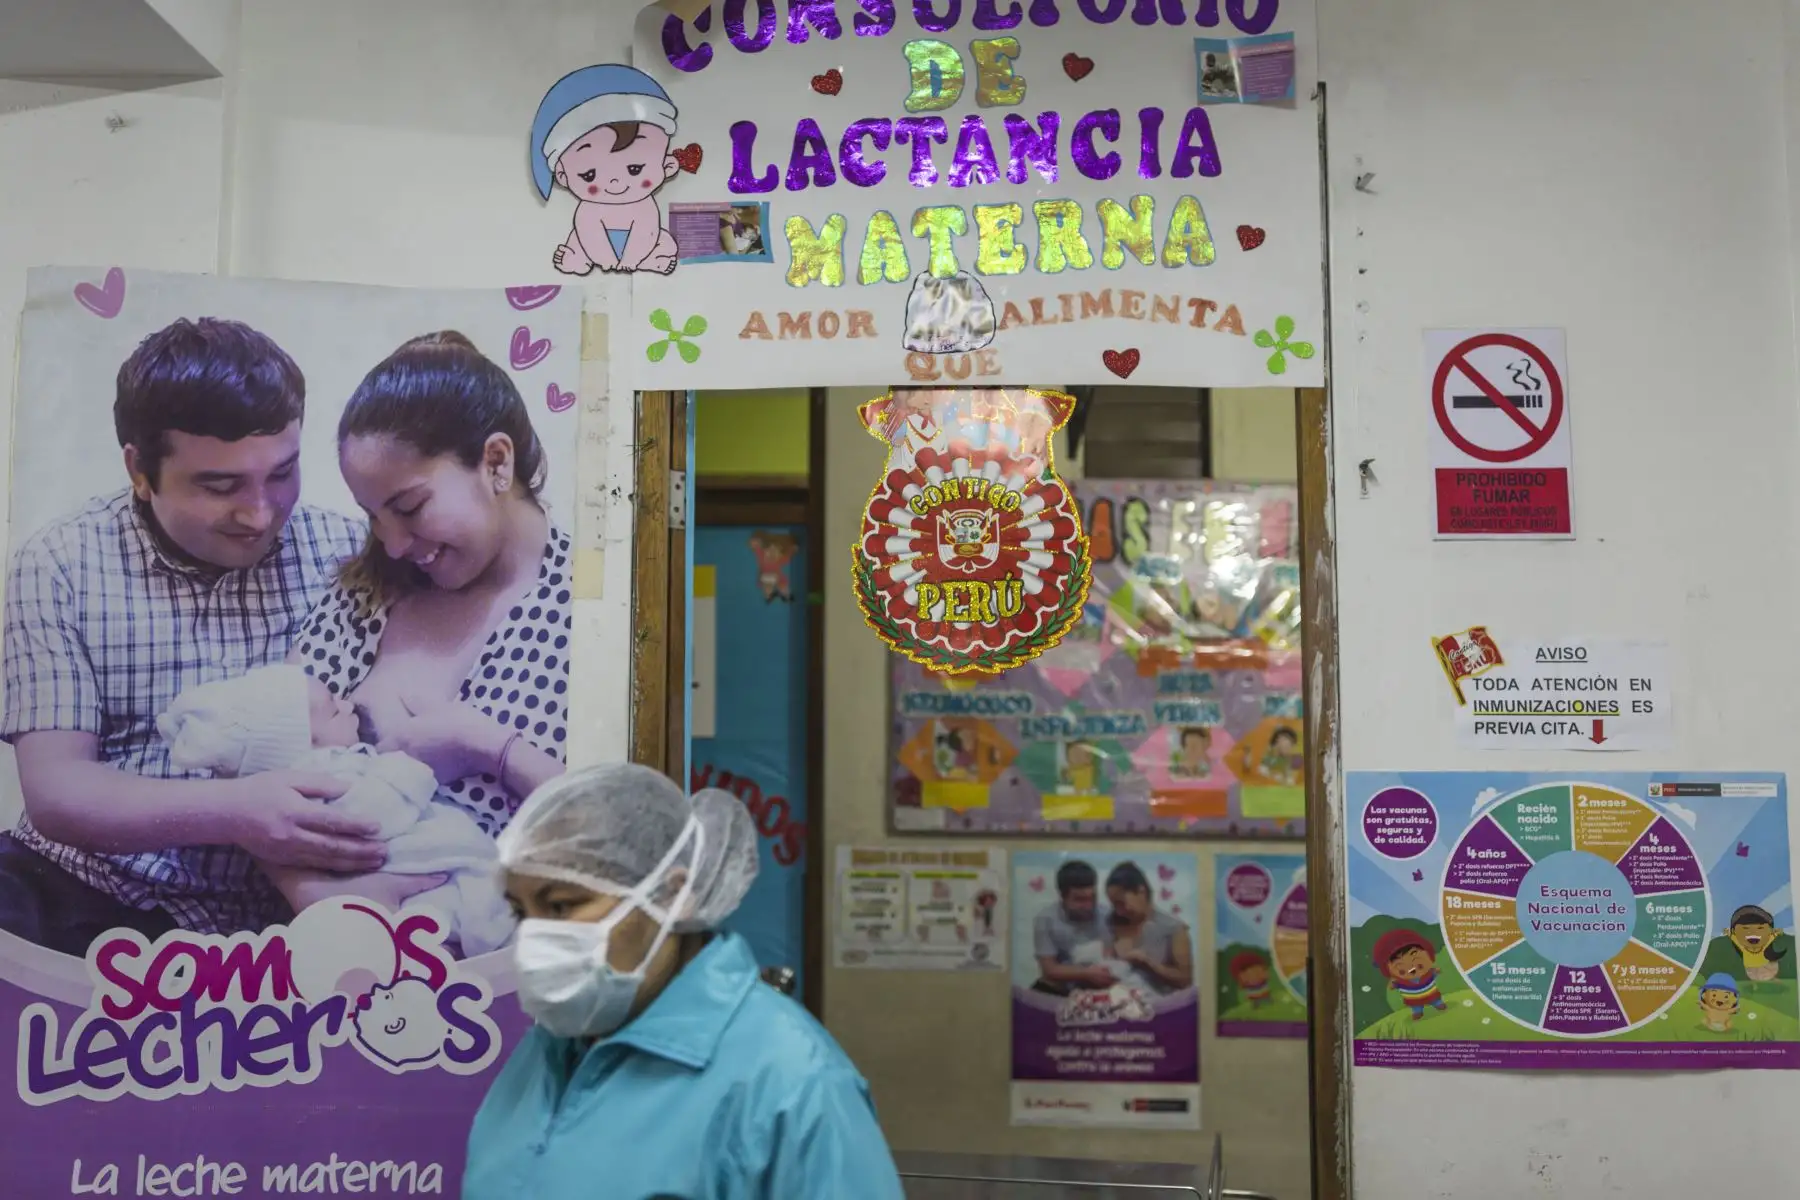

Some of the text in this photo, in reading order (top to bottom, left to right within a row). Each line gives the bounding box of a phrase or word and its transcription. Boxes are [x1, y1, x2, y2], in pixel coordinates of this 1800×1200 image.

[902, 36, 1027, 113] DE
[727, 106, 1222, 194] LACTANCIA
[784, 194, 1216, 287] MATERNA
[997, 287, 1247, 336] ALIMENTA
[738, 310, 878, 341] AMOR
[904, 347, 1003, 381] QUE
[1456, 472, 1547, 487] PROHIBIDO
[909, 477, 1022, 515] CONTIGO
[1473, 489, 1531, 503] FUMAR
[915, 572, 1025, 624] PERÚ
[1535, 647, 1588, 661] AVISO
[1473, 675, 1652, 692] TODA ATENCIÓN EN
[1473, 700, 1653, 713] INMUNIZACIONES ES
[1474, 722, 1584, 735] PREVIA CITA.
[1577, 794, 1588, 807] 2
[1371, 806, 1386, 814] Las
[1517, 803, 1557, 814] Recién
[1385, 816, 1432, 826] gratuitas,
[1517, 814, 1558, 824] nacido
[1376, 827, 1414, 835] seguras
[1374, 835, 1426, 844] de calidad.
[1649, 832, 1660, 845] 4
[1466, 846, 1507, 860] 4 años
[1640, 845, 1677, 853] meses
[1540, 885, 1612, 900] Esquema
[1445, 896, 1502, 909] 18 meses
[1528, 902, 1626, 914] Nacional de
[1645, 902, 1693, 914] 6 meses
[1490, 962, 1546, 975] 15 meses
[1611, 963, 1675, 976] 7 y 8 meses
[1569, 970, 1587, 984] 12
[1563, 985, 1602, 993] meses
[71, 1153, 443, 1196] La leche materna
